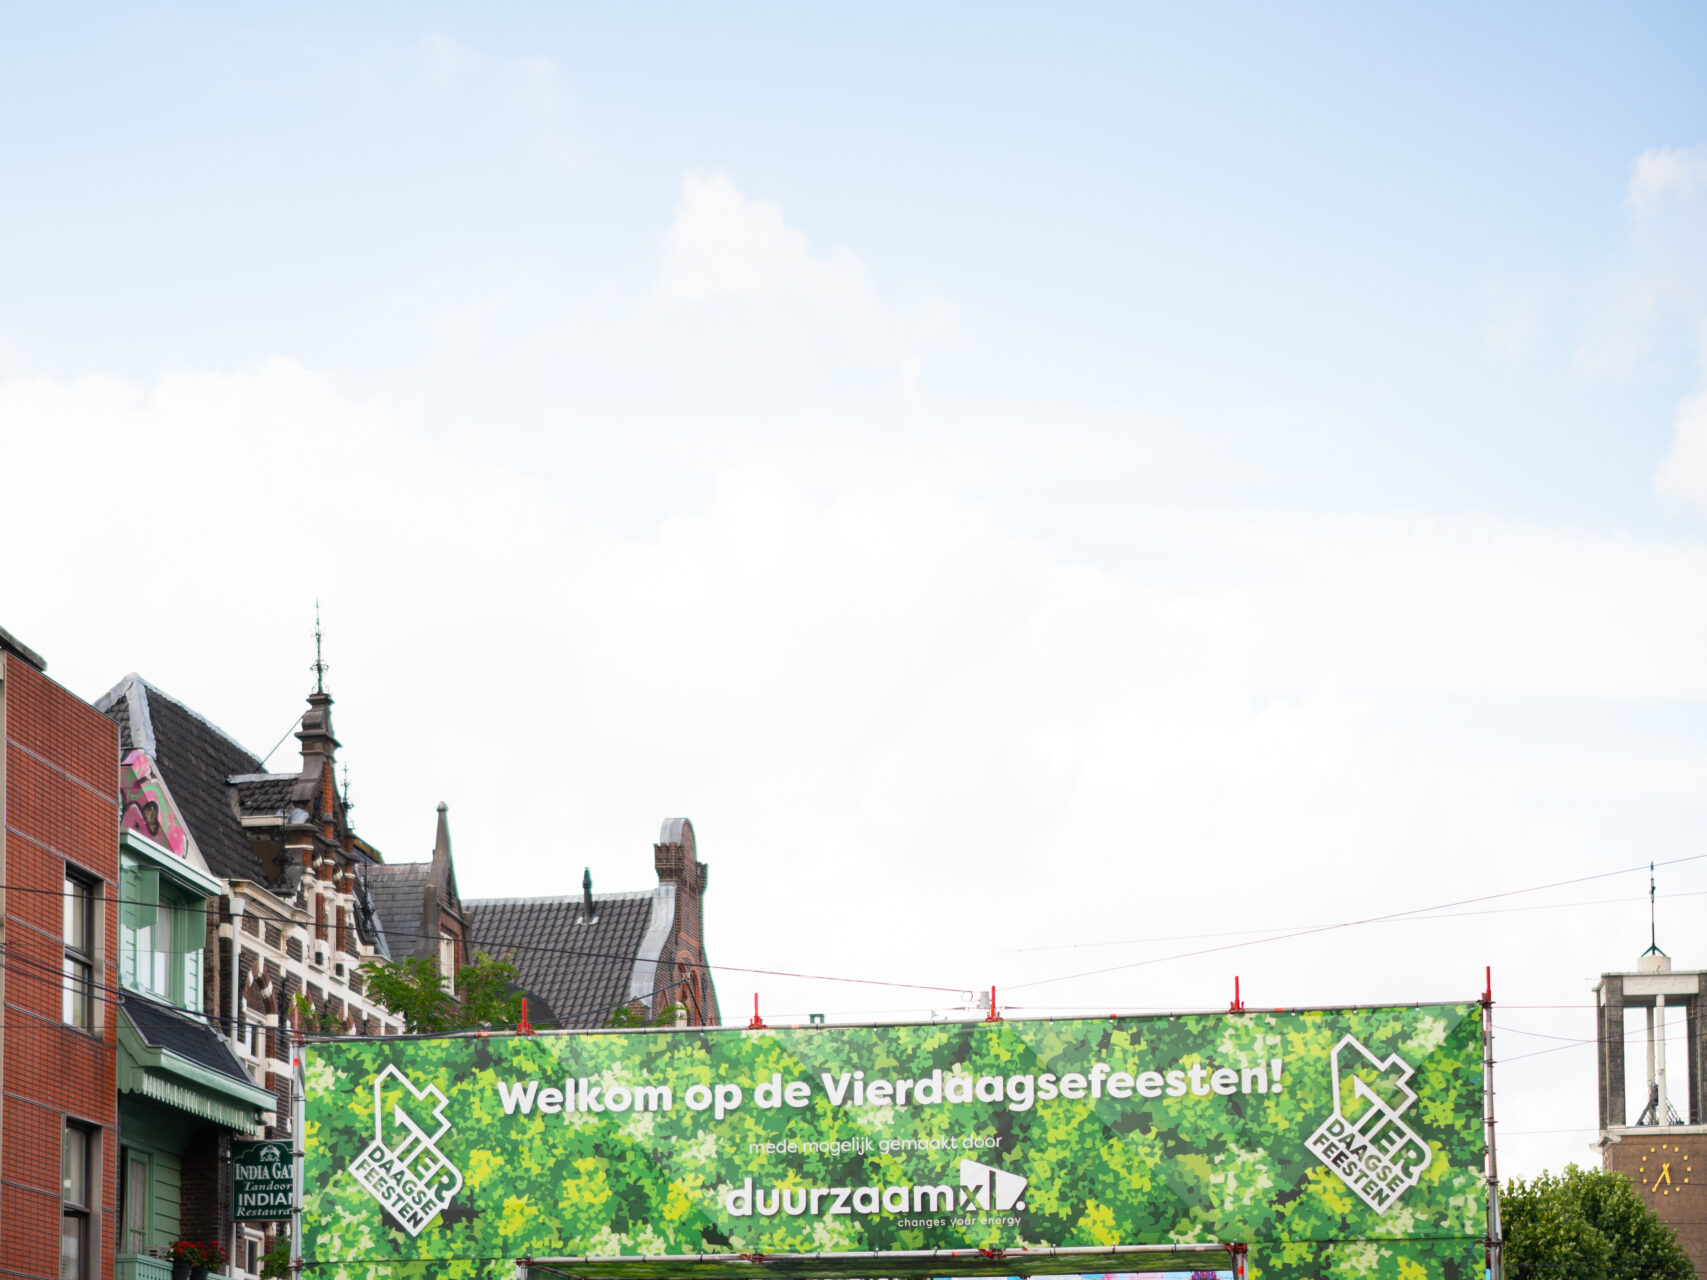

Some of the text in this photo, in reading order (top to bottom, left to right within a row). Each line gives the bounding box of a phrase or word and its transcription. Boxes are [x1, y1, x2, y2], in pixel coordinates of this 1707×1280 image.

[496, 1059, 1284, 1120] Welkom op de Vierdaagsefeesten!
[749, 1133, 1002, 1156] mede mogelijk gemaakt door
[1326, 1118, 1405, 1193] DAAGSE
[235, 1164, 270, 1180] INDIA
[244, 1181, 293, 1191] Tandoor
[368, 1145, 438, 1216] DAAGSE
[1312, 1132, 1391, 1207] FEESTEN
[236, 1207, 290, 1217] Restaura
[355, 1158, 424, 1229] FEESTEN
[897, 1215, 1022, 1229] changes your energy
